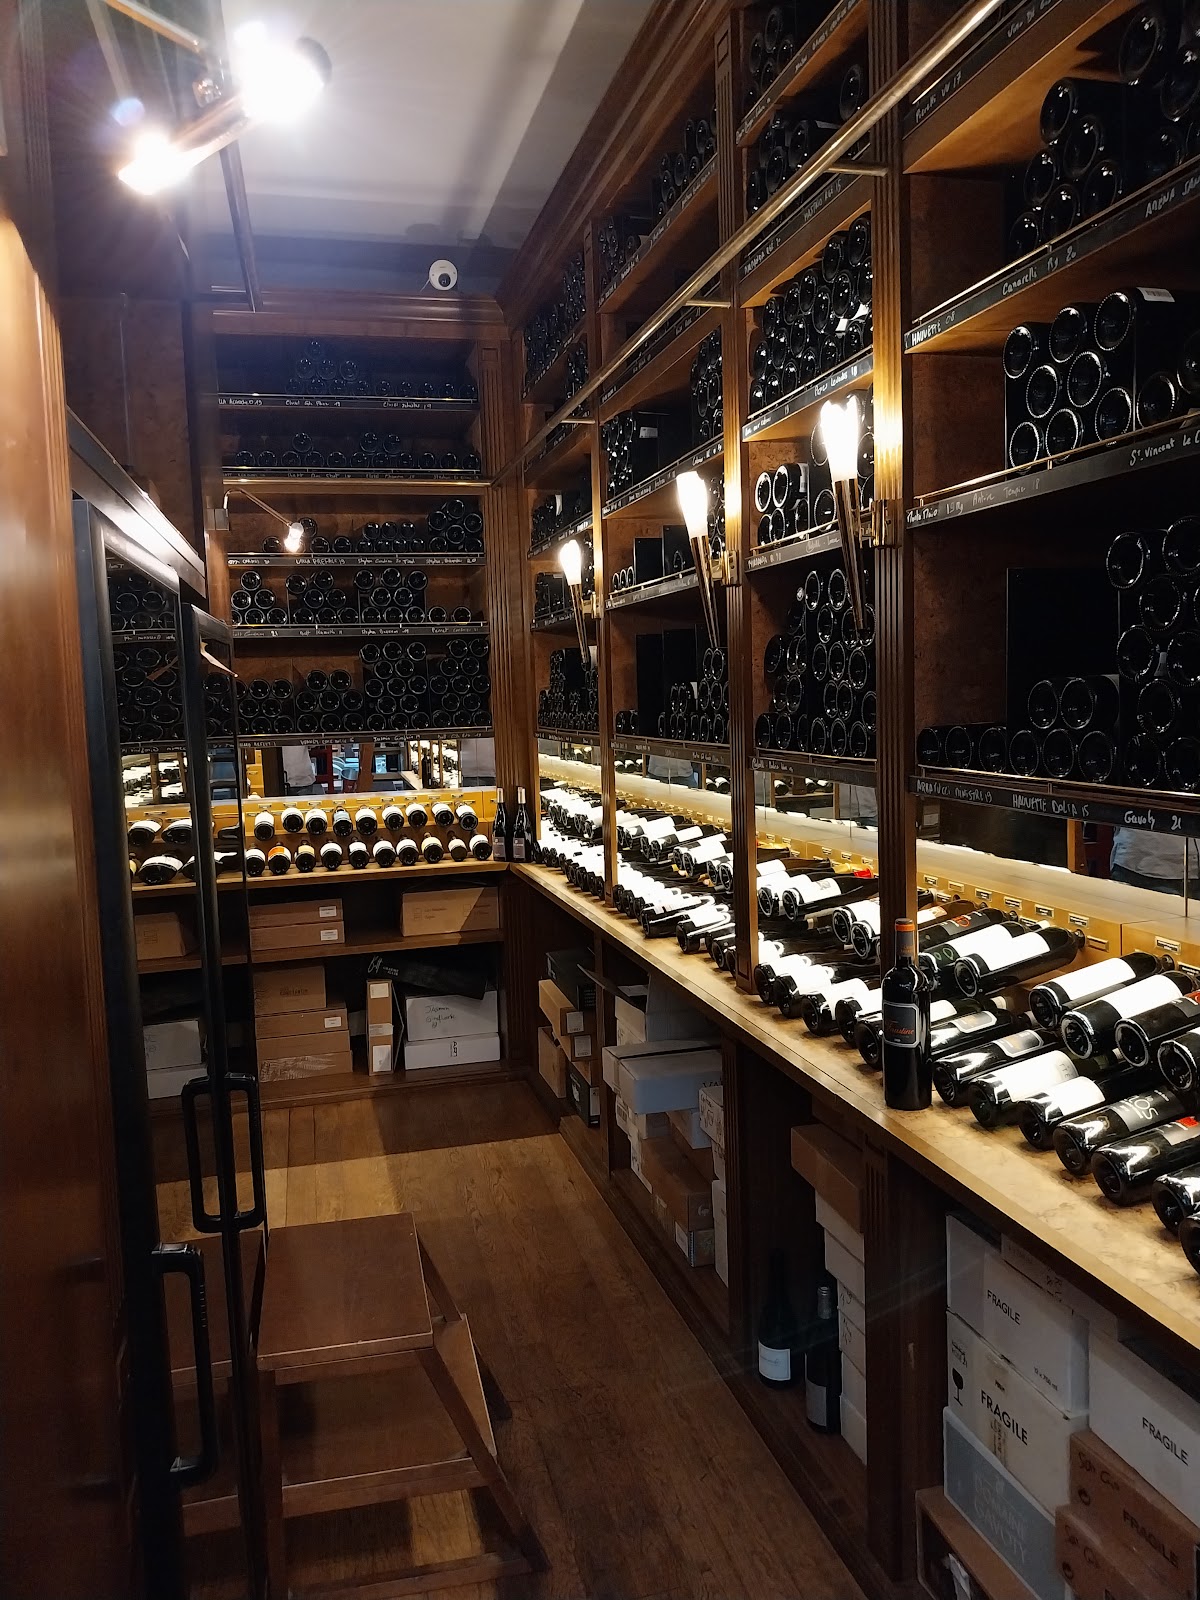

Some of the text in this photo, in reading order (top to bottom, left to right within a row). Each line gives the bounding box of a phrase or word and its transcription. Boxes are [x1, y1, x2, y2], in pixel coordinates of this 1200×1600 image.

[987, 1289, 1021, 1325] FRAGILE
[980, 1388, 1028, 1446] FRAGILE
[1142, 1416, 1189, 1467] FRAGILE
[1122, 1509, 1179, 1568] FRAGILE
